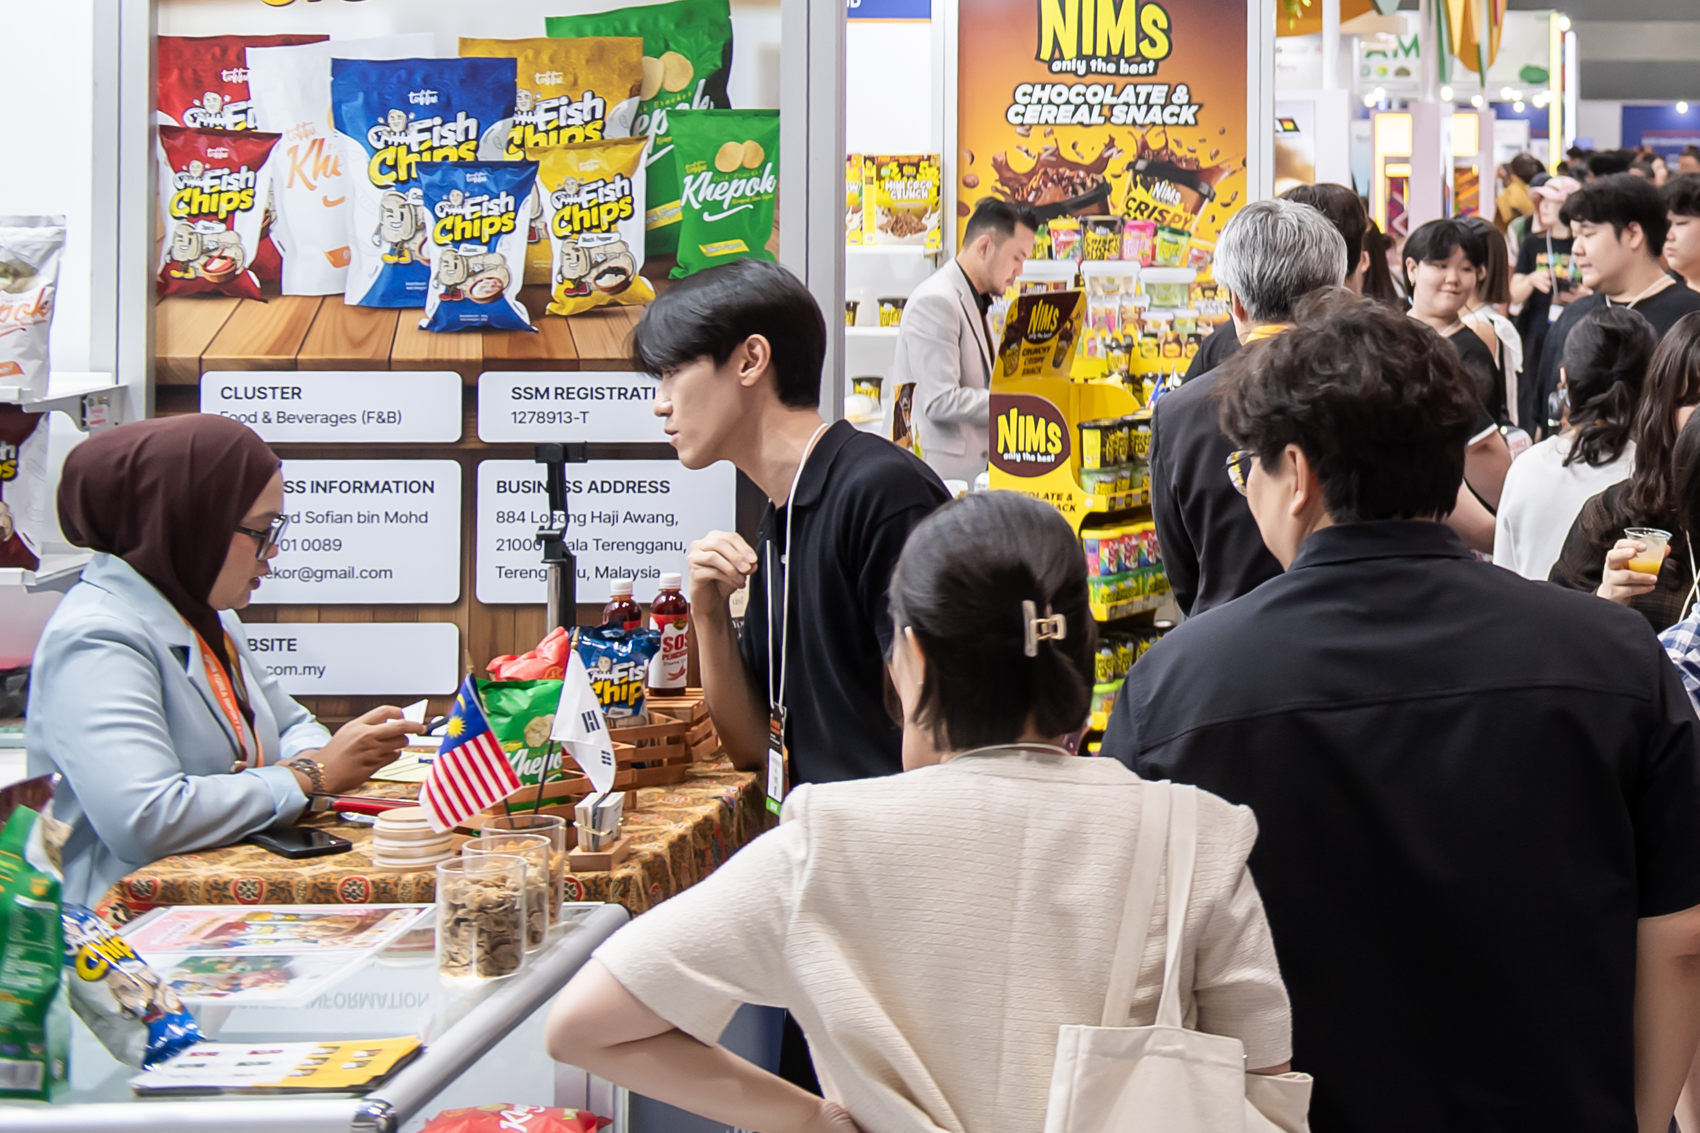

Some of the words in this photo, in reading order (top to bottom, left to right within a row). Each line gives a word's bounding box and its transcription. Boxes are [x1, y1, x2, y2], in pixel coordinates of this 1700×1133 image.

[1051, 57, 1087, 75] only
[1090, 58, 1116, 74] the
[1014, 84, 1170, 105] CHOCOLATE
[1172, 84, 1190, 105] &
[535, 90, 606, 132] Fish
[1006, 104, 1106, 125] CEREAL
[1110, 104, 1200, 125] SNACK
[408, 110, 478, 153] Fish
[203, 165, 255, 193] Fish
[680, 162, 777, 210] Khepok
[580, 174, 632, 209] Fish
[1152, 180, 1182, 206] NIMS
[169, 187, 255, 220] Chips
[465, 189, 515, 221] Fish
[1125, 197, 1193, 230] CRISPY
[552, 194, 633, 238] Chips
[433, 211, 516, 245] Chips
[1028, 299, 1060, 334] NIMS
[220, 386, 302, 400] CLUSTER
[511, 386, 550, 400] SSM
[554, 386, 656, 400] REGISTRATI
[262, 411, 272, 424] &
[276, 411, 356, 427] Beverages
[361, 410, 402, 425] (F&B)
[511, 411, 589, 424] 1278913-T
[997, 407, 1063, 454] NIMS
[310, 480, 435, 494] INFORMATION
[496, 480, 582, 494] BUSINSS
[587, 480, 670, 494] ADDRESS
[1027, 492, 1063, 502] OLATE
[305, 511, 353, 524] Sofian
[357, 511, 380, 524] bin
[384, 511, 428, 524] Mohd
[496, 511, 526, 524] 884
[591, 510, 619, 527] Haji
[623, 511, 679, 527] Awang,
[1054, 503, 1076, 513] ACK
[301, 538, 342, 551] 0089
[495, 538, 541, 551] 21000
[567, 538, 588, 551] ala
[592, 538, 687, 554] Terengganu,
[265, 566, 393, 582] ekor@gmail.com
[495, 566, 590, 582] Terengu,
[247, 638, 297, 652] BSITE
[592, 677, 643, 707] hip
[75, 935, 136, 982] Chip
